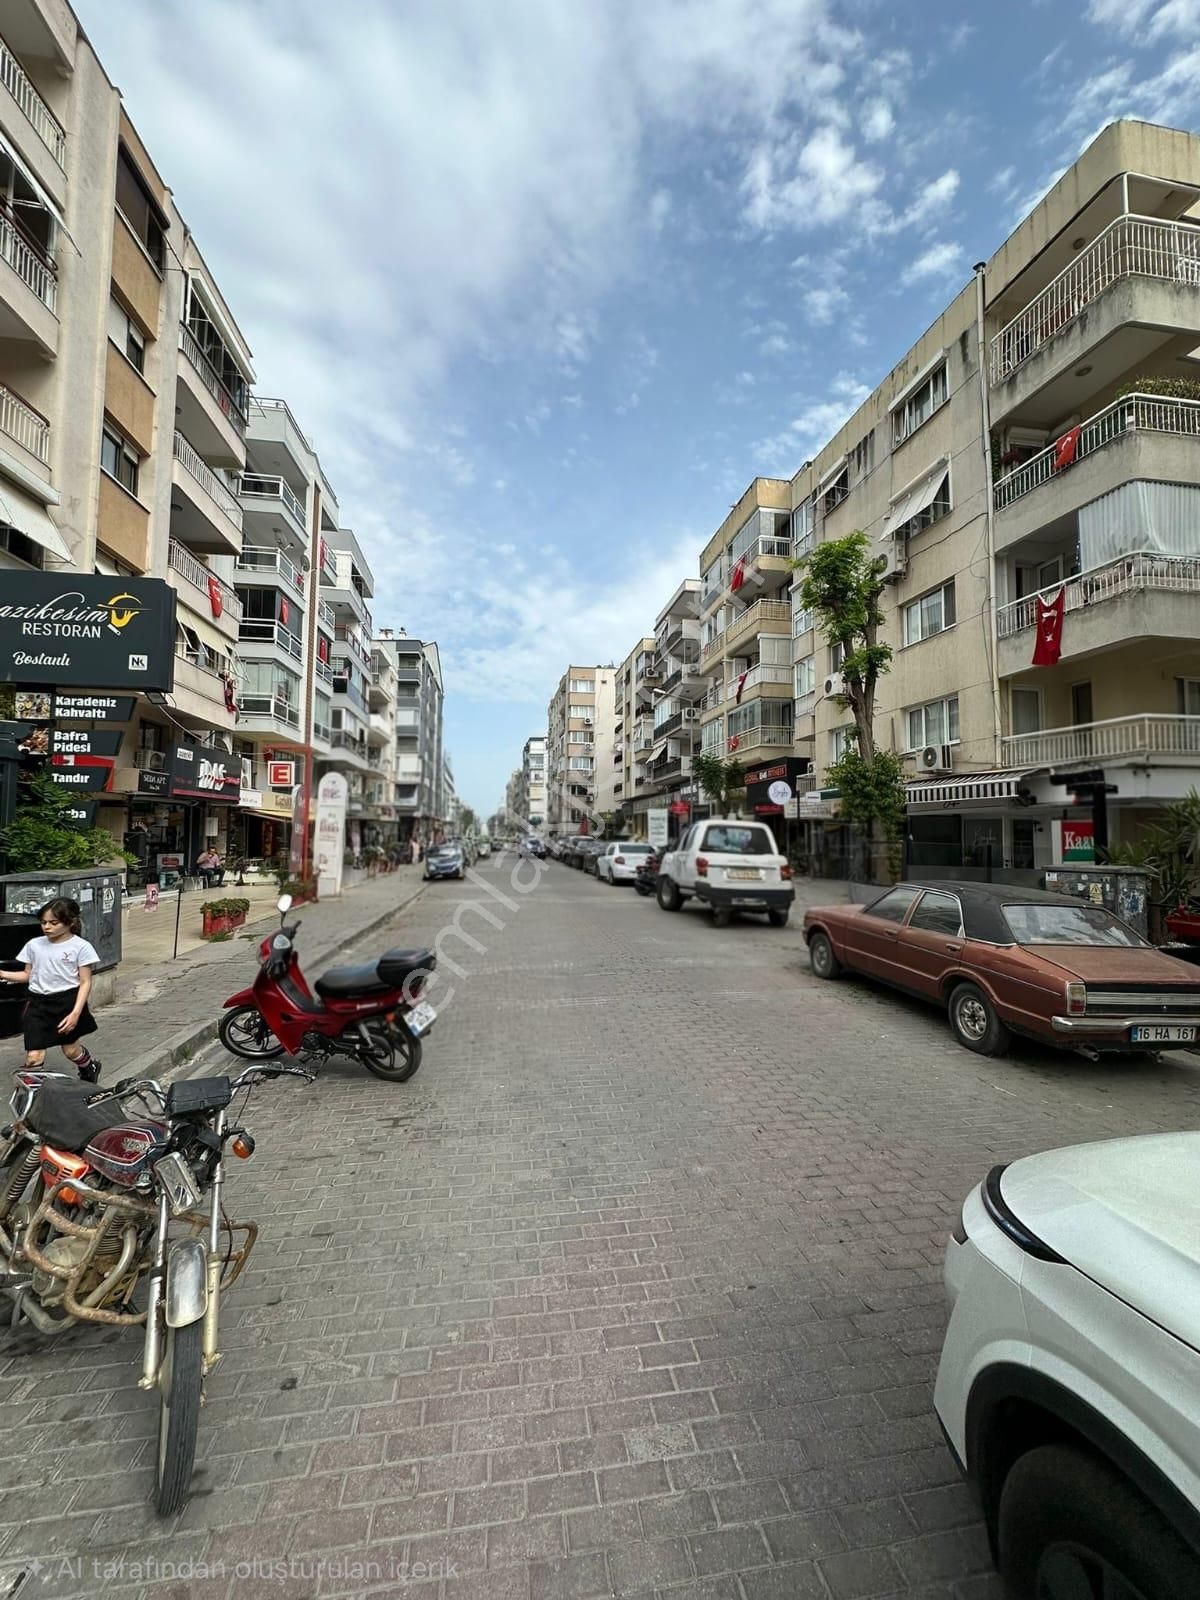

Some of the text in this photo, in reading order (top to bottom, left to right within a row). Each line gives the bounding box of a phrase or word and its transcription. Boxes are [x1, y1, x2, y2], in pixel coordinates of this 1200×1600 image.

[22, 622, 101, 638] RESTORAN
[12, 651, 71, 667] Bostanlı
[55, 695, 117, 708] Karadeniz
[55, 707, 106, 718] Kahvaltı
[53, 730, 89, 741] Bafra
[53, 742, 91, 753] Pidesi
[51, 773, 90, 784] Tandır
[273, 765, 289, 782] E
[1138, 1027, 1194, 1040] 16 HA 161
